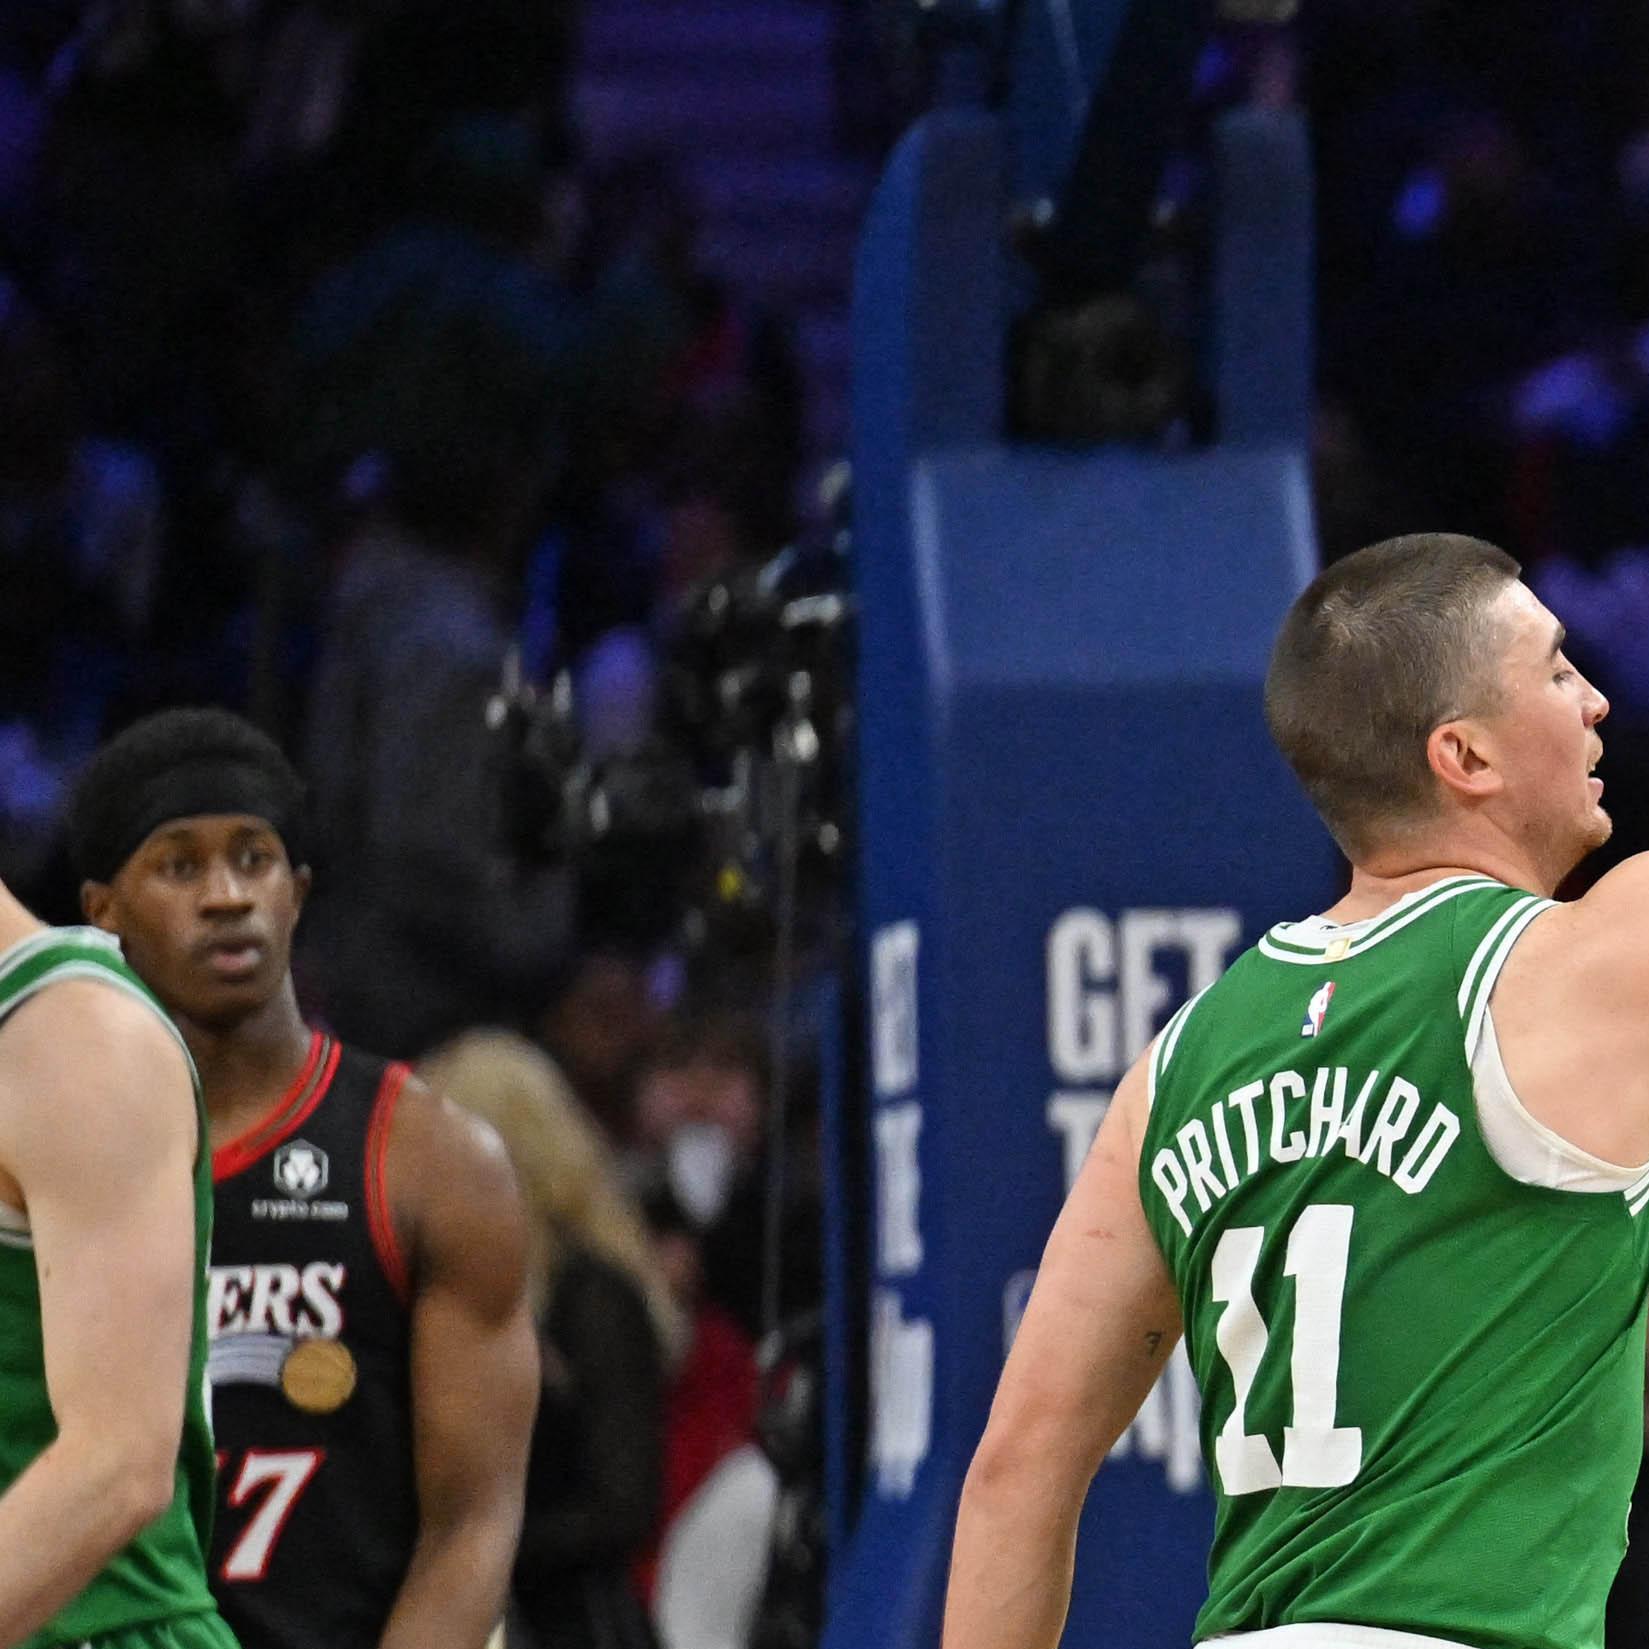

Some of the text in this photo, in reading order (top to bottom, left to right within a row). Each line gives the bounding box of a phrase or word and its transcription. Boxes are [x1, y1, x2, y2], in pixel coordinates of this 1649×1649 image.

[1151, 1066, 1461, 1238] PRITCHARD
[1211, 1204, 1363, 1496] 11
[215, 1447, 327, 1584] 7
